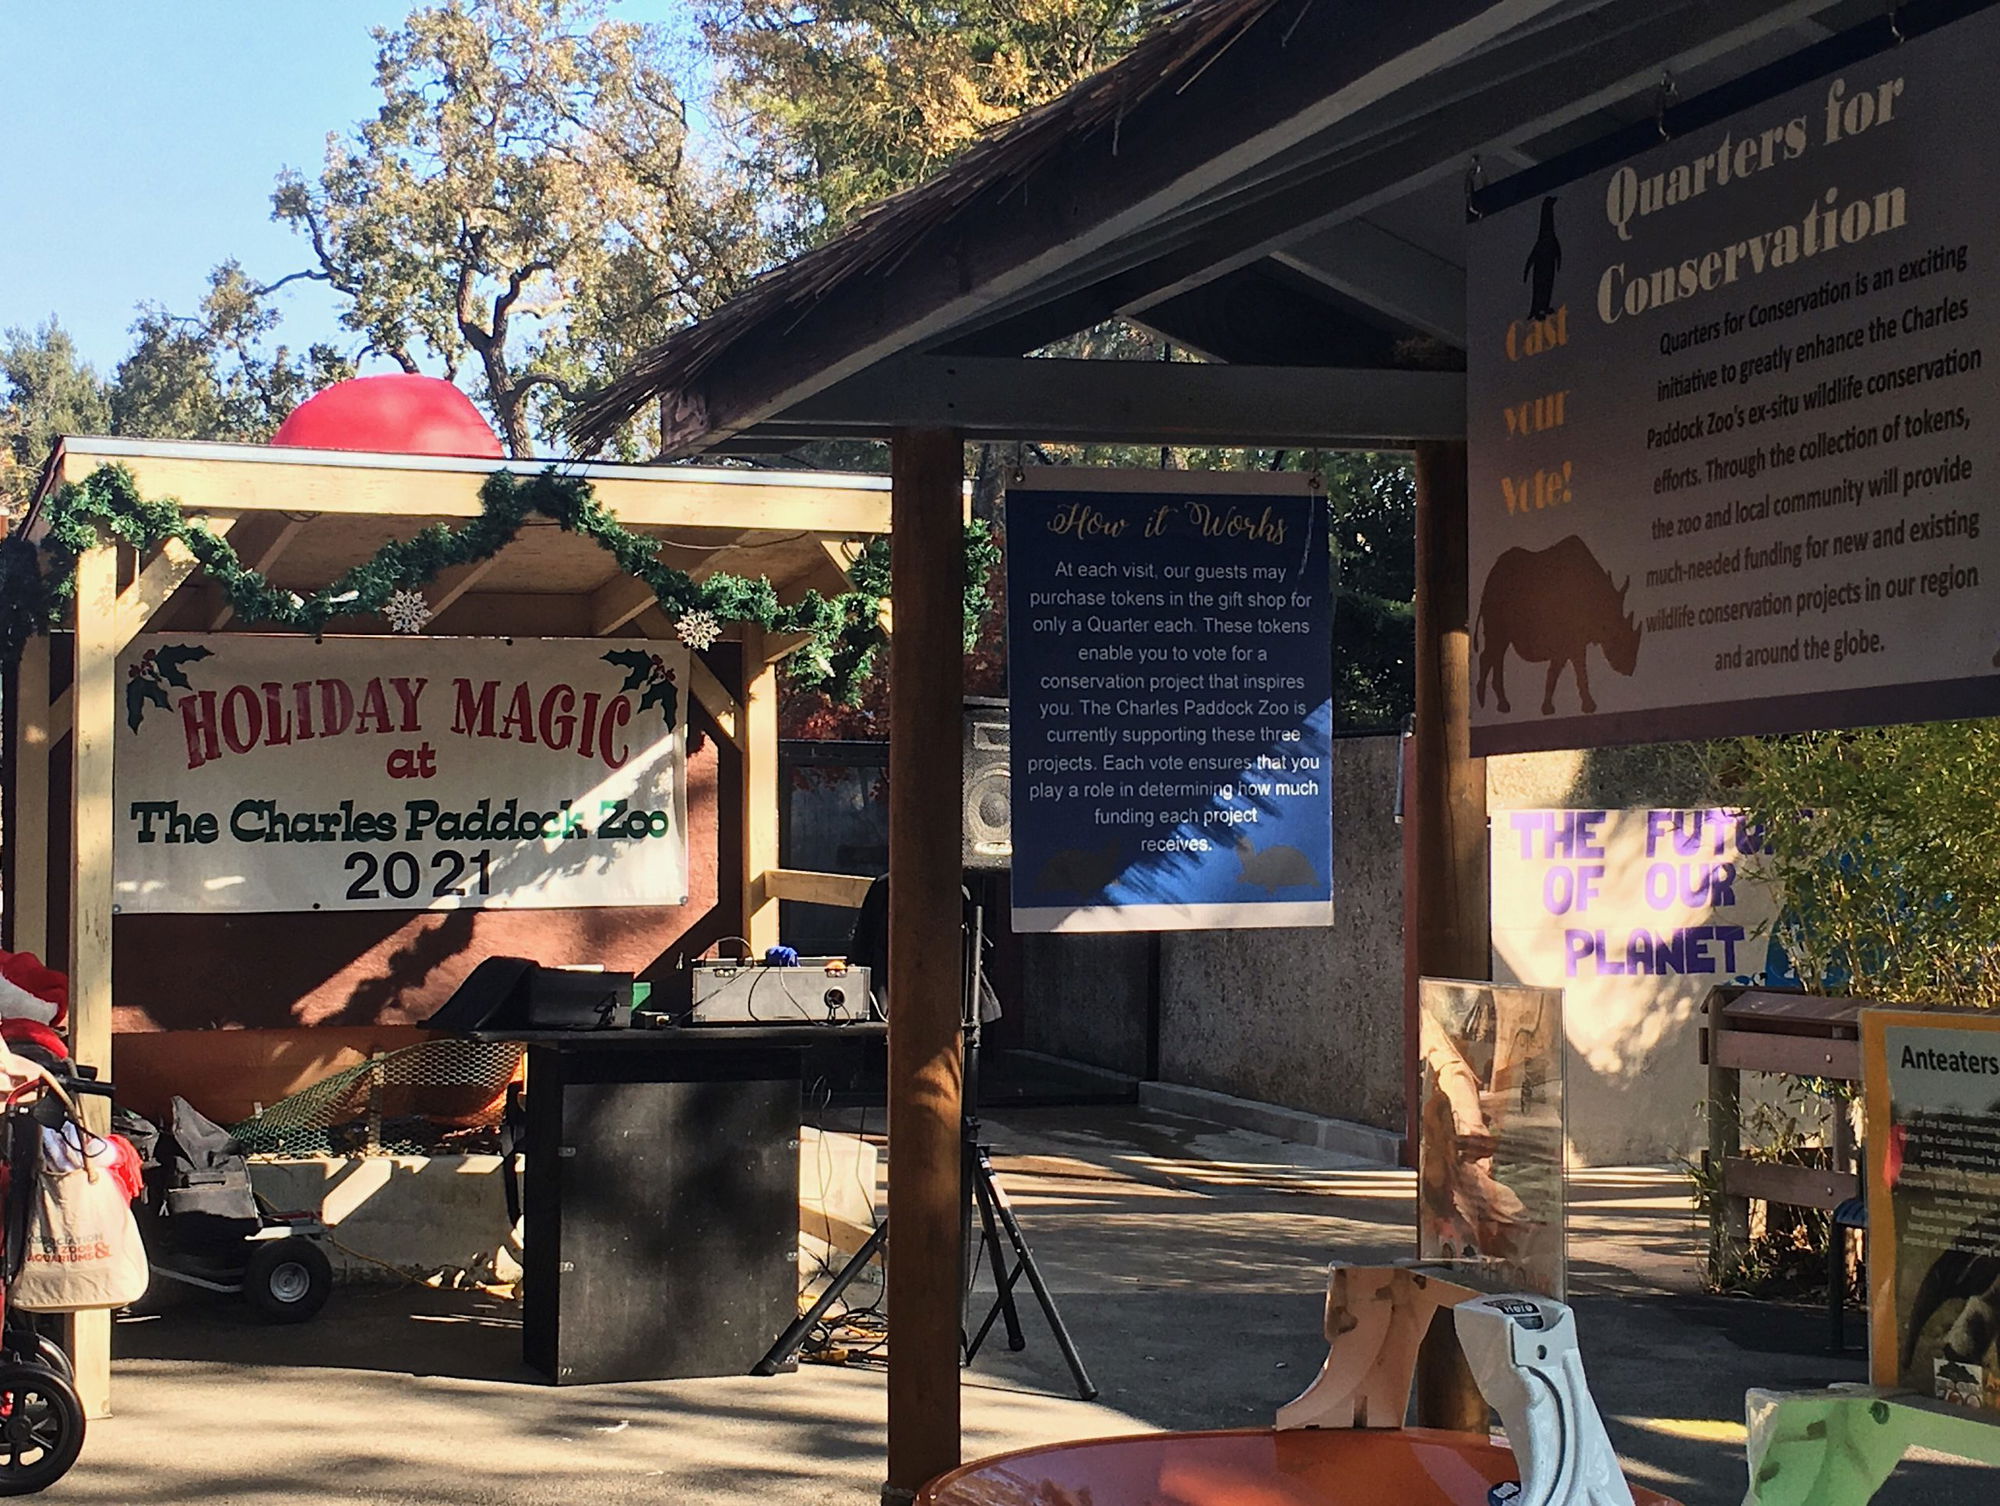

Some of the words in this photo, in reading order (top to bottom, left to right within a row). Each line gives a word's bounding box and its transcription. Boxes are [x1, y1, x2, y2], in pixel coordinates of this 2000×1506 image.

[1606, 115, 1807, 240] Quarters
[1823, 77, 1905, 145] for
[1598, 186, 1907, 323] Conservation
[1660, 322, 1720, 356] Quarters
[1724, 312, 1745, 336] for
[1749, 281, 1850, 327] Conservation
[1856, 273, 1868, 296] is
[1873, 268, 1893, 291] an
[1899, 245, 1968, 282] exciting
[1506, 304, 1569, 362] Cast
[1657, 369, 1717, 402] initiative
[1721, 364, 1736, 384] to
[1740, 344, 1792, 384] greatly
[1796, 329, 1864, 363] enhance
[1868, 318, 1897, 343] the
[1902, 299, 1968, 334] Charles
[1503, 390, 1571, 440] your
[1647, 415, 1703, 450] Paddock
[1707, 405, 1745, 435] Zoo's
[1749, 394, 1799, 425] ex-situ
[1803, 375, 1862, 411] wildlife
[1867, 348, 1981, 395] conservation
[1653, 467, 1702, 494] efforts.
[1705, 447, 1765, 482] Through
[1769, 442, 1795, 468] the
[1799, 425, 1877, 462] collection
[1883, 416, 1901, 443] of
[1904, 407, 1974, 438] tokens,
[1501, 460, 1573, 517] Vote!
[1651, 517, 1674, 540] the
[1677, 515, 1701, 536] zoo
[1705, 502, 1732, 530] and
[1736, 493, 1769, 524] local
[1774, 478, 1864, 516] community
[1868, 467, 1898, 498] will
[1903, 455, 1972, 497] provide
[1047, 502, 1130, 539] How
[1145, 505, 1178, 537] it
[1185, 501, 1288, 545] Works
[1054, 560, 1074, 577] At
[1077, 561, 1118, 578] each
[1121, 561, 1159, 580] visit,
[1163, 565, 1191, 579] our
[1194, 564, 1248, 583] guests
[1252, 567, 1287, 584] may
[1646, 548, 1740, 588] much-needed
[1744, 541, 1802, 570] funding
[1806, 535, 1829, 560] for
[1833, 532, 1868, 556] new
[1873, 519, 1904, 549] and
[1910, 510, 1980, 542] existing
[1029, 588, 1106, 609] purchase
[1110, 589, 1165, 607] tokens
[1169, 590, 1184, 607] in
[1188, 590, 1214, 608] the
[1217, 590, 1244, 611] gift
[1247, 591, 1287, 611] shop
[1290, 587, 1313, 608] for
[1646, 604, 1695, 632] wildlife
[1699, 592, 1792, 625] conservation
[1797, 582, 1861, 617] projects
[1865, 577, 1881, 601] in
[1886, 577, 1916, 598] our
[1921, 564, 1979, 598] region
[1032, 615, 1067, 636] only
[1071, 619, 1083, 633] a
[1087, 615, 1150, 633] Quarter
[1153, 616, 1198, 633] each.
[1202, 616, 1253, 634] These
[1257, 617, 1311, 634] tokens
[1714, 644, 1741, 671] and
[1745, 637, 1799, 667] around
[1803, 635, 1830, 660] the
[1834, 629, 1885, 663] globe.
[1077, 644, 1134, 661] enable
[1137, 648, 1168, 665] you
[1171, 645, 1188, 662] to
[1192, 645, 1227, 662] vote
[1231, 644, 1254, 662] for
[1257, 648, 1268, 662] a
[1039, 672, 1145, 690] conservation
[1149, 674, 1205, 693] project
[1208, 672, 1240, 690] that
[1243, 673, 1306, 693] inspires
[178, 677, 429, 771] HOLIDAY
[451, 679, 632, 771] MAGIC
[1039, 702, 1075, 720] you.
[1078, 699, 1112, 716] The
[1116, 699, 1179, 716] Charles
[1184, 699, 1254, 716] Paddock
[1257, 699, 1290, 716] Zoo
[1293, 699, 1309, 717] is
[386, 741, 437, 779] at
[1046, 726, 1118, 747] currently
[1122, 725, 1207, 746] supporting
[1211, 725, 1256, 743] these
[1260, 725, 1302, 743] three
[1027, 754, 1098, 776] projects.
[1103, 754, 1145, 771] Each
[1148, 755, 1184, 771] vote
[1188, 756, 1253, 772] ensures
[1256, 753, 1288, 771] that
[1290, 756, 1322, 774] you
[1029, 781, 1064, 803] play
[1068, 784, 1080, 798] a
[1083, 781, 1115, 798] role
[1119, 781, 1134, 797] in
[1138, 780, 1234, 801] determining
[1237, 780, 1271, 798] how
[1273, 779, 1320, 798] much
[130, 801, 219, 845] The
[231, 799, 397, 844] Charles
[405, 798, 584, 843] Paddock
[598, 797, 669, 841] Zoo
[1094, 807, 1155, 828] funding
[1159, 807, 1199, 825] each
[1203, 805, 1259, 825] project
[1511, 811, 1606, 860] THE
[1140, 834, 1214, 854] receives.
[344, 849, 490, 900] 2021
[1543, 865, 1605, 916] OF
[1645, 862, 1738, 911] OUR
[1564, 925, 1745, 978] PLANET
[1901, 1045, 2000, 1075] Anteaters
